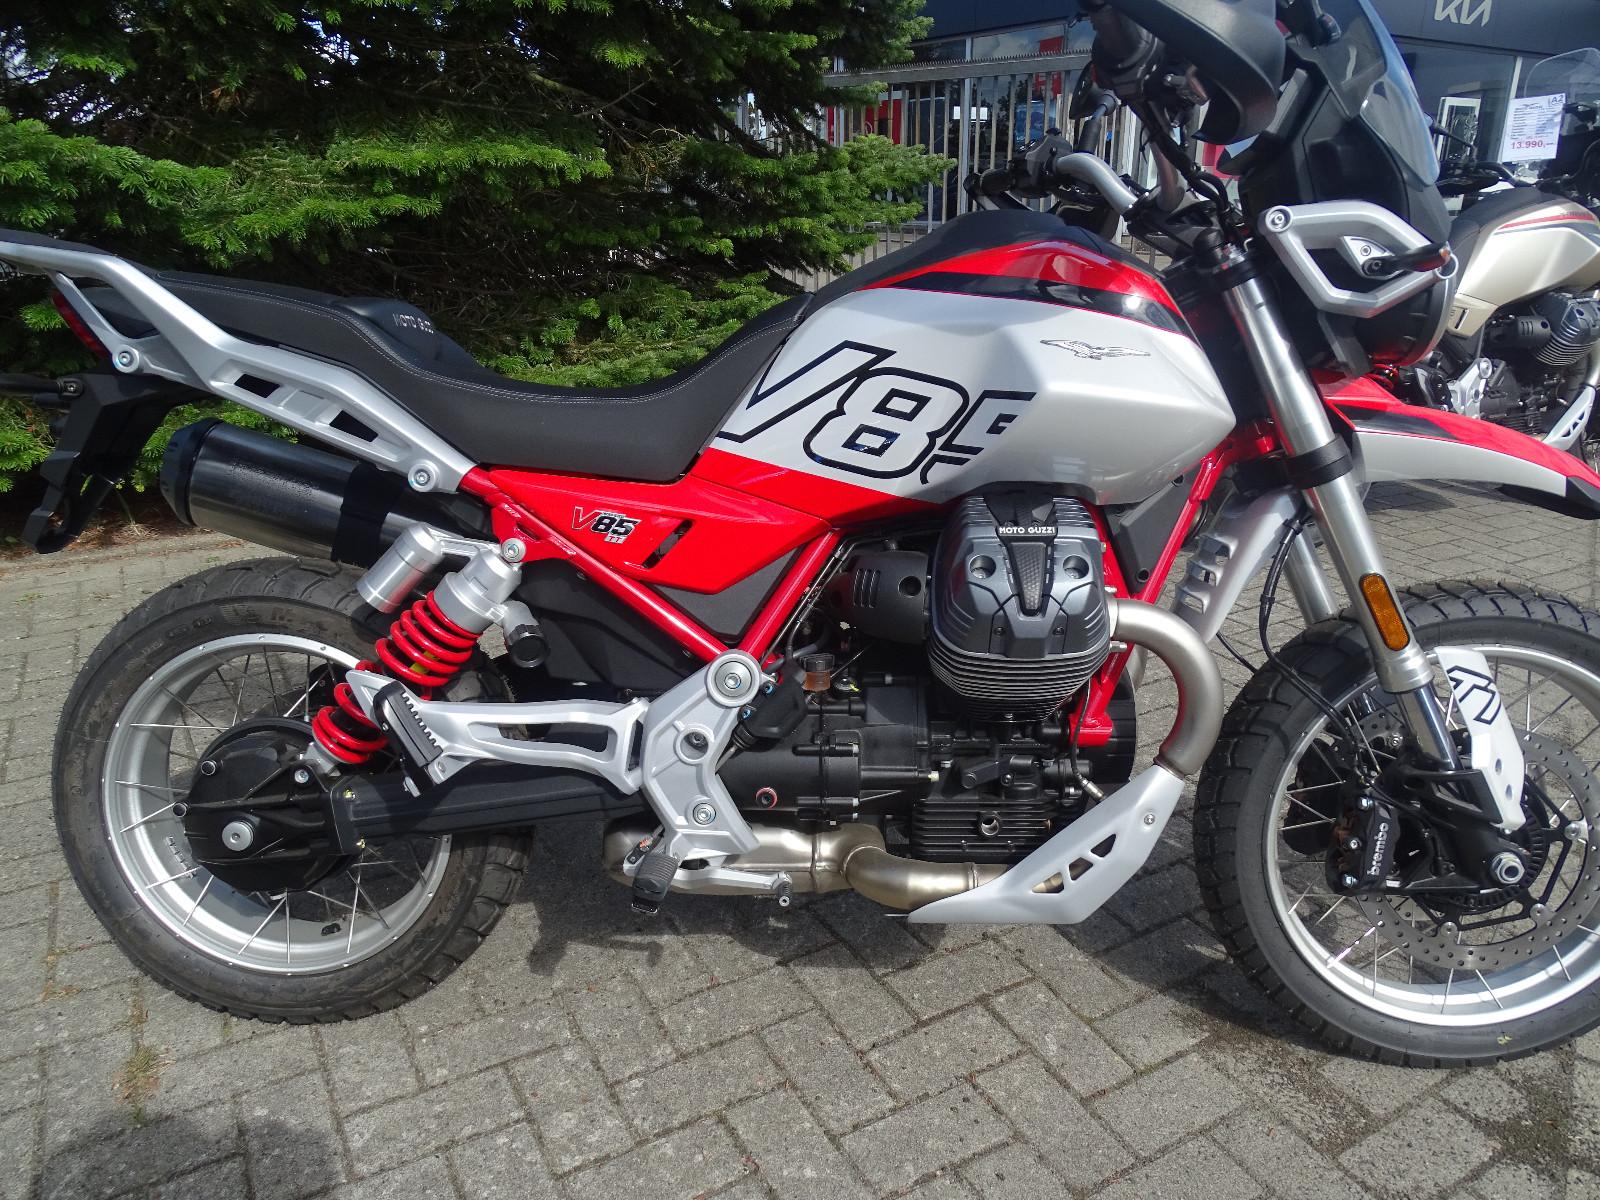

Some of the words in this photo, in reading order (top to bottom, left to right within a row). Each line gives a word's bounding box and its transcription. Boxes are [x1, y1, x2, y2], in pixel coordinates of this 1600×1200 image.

[1434, 0, 1492, 27] KIA
[572, 506, 641, 536] V85
[999, 526, 1025, 534] MOTO
[1028, 526, 1055, 534] GUZZI
[607, 535, 624, 544] TT
[1367, 822, 1389, 876] brembo
